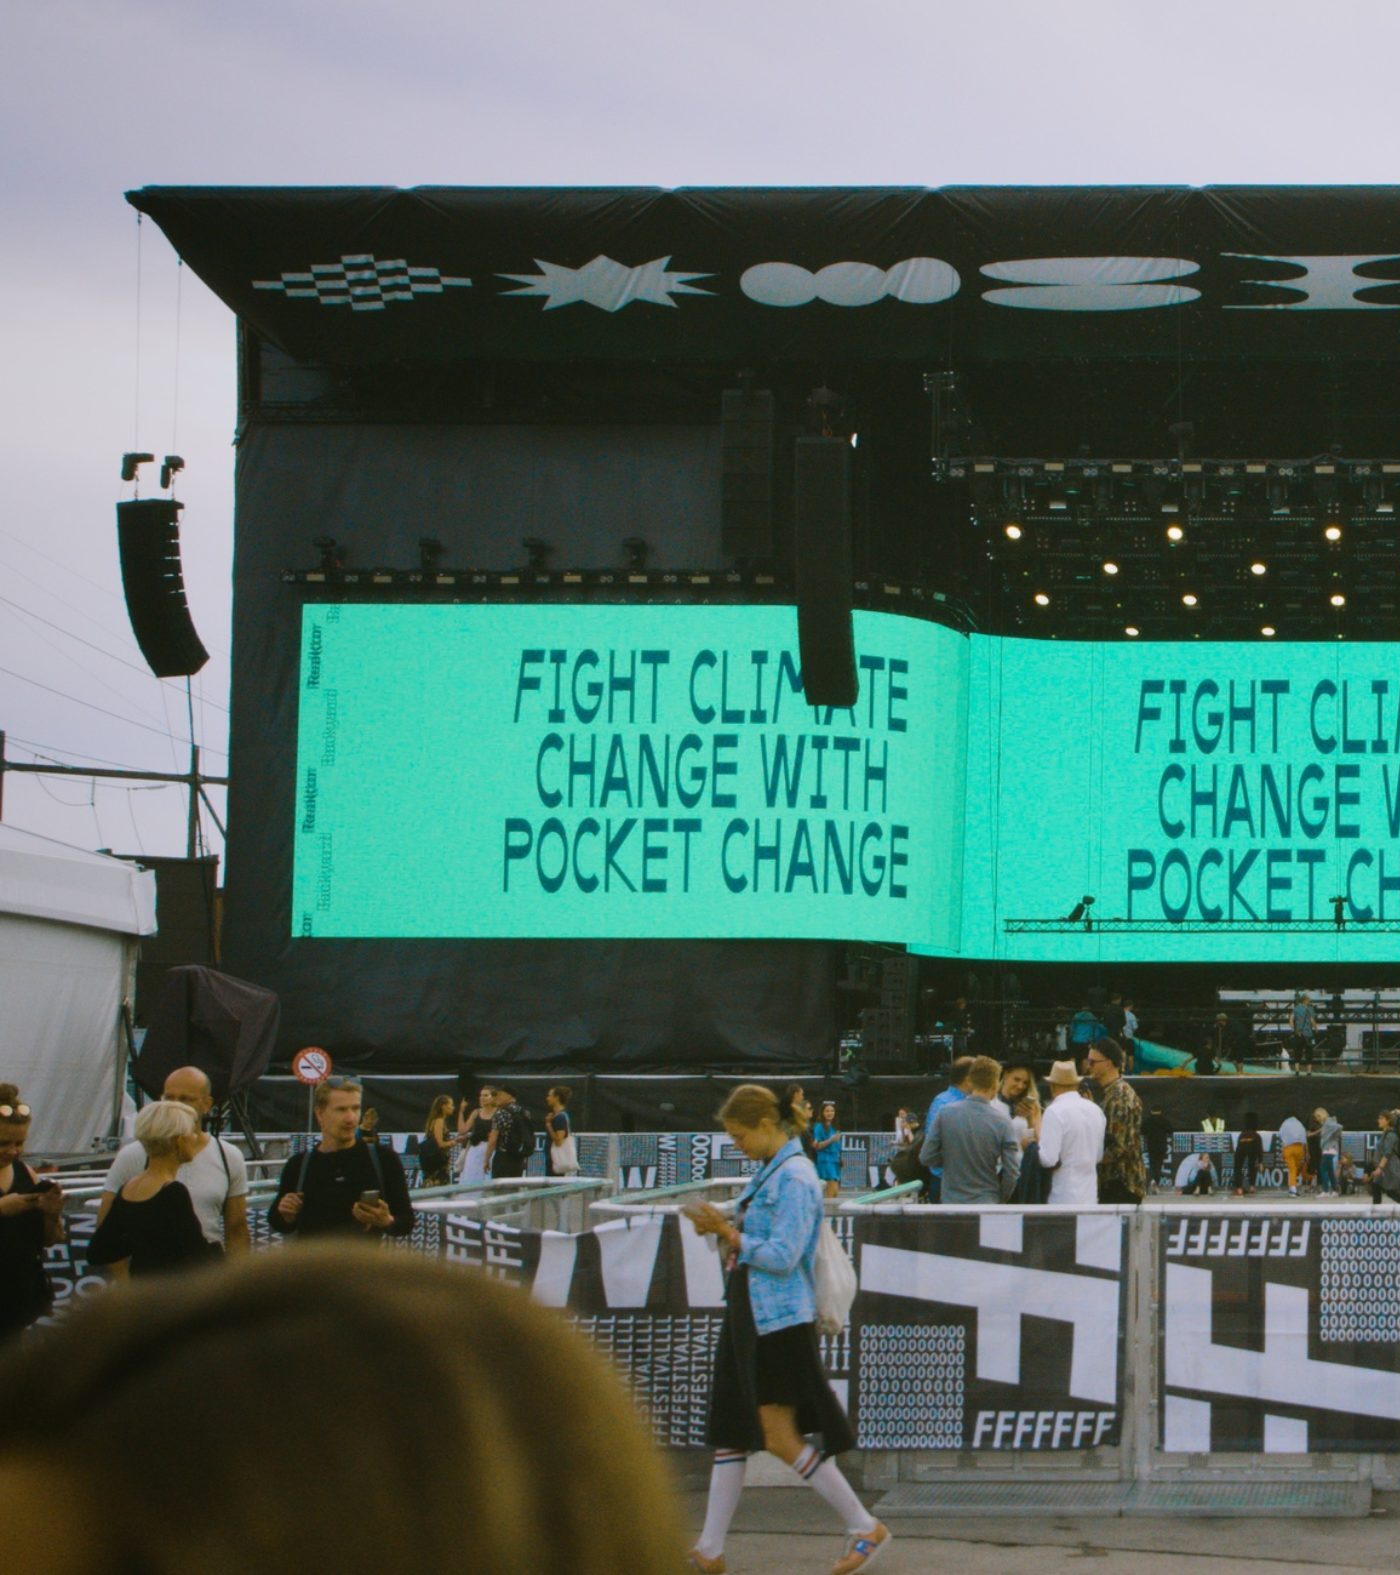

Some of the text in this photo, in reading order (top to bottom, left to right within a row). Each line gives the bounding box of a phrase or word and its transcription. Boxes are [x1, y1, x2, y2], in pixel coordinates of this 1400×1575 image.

[514, 649, 909, 732] FIGHT CLIMTE
[1134, 679, 1290, 754] FIGHT
[536, 733, 889, 813] CHANGE WITH
[1158, 764, 1362, 839] CHANGE
[503, 818, 910, 898] POCKET CHANGE
[1127, 848, 1327, 924] POCKET
